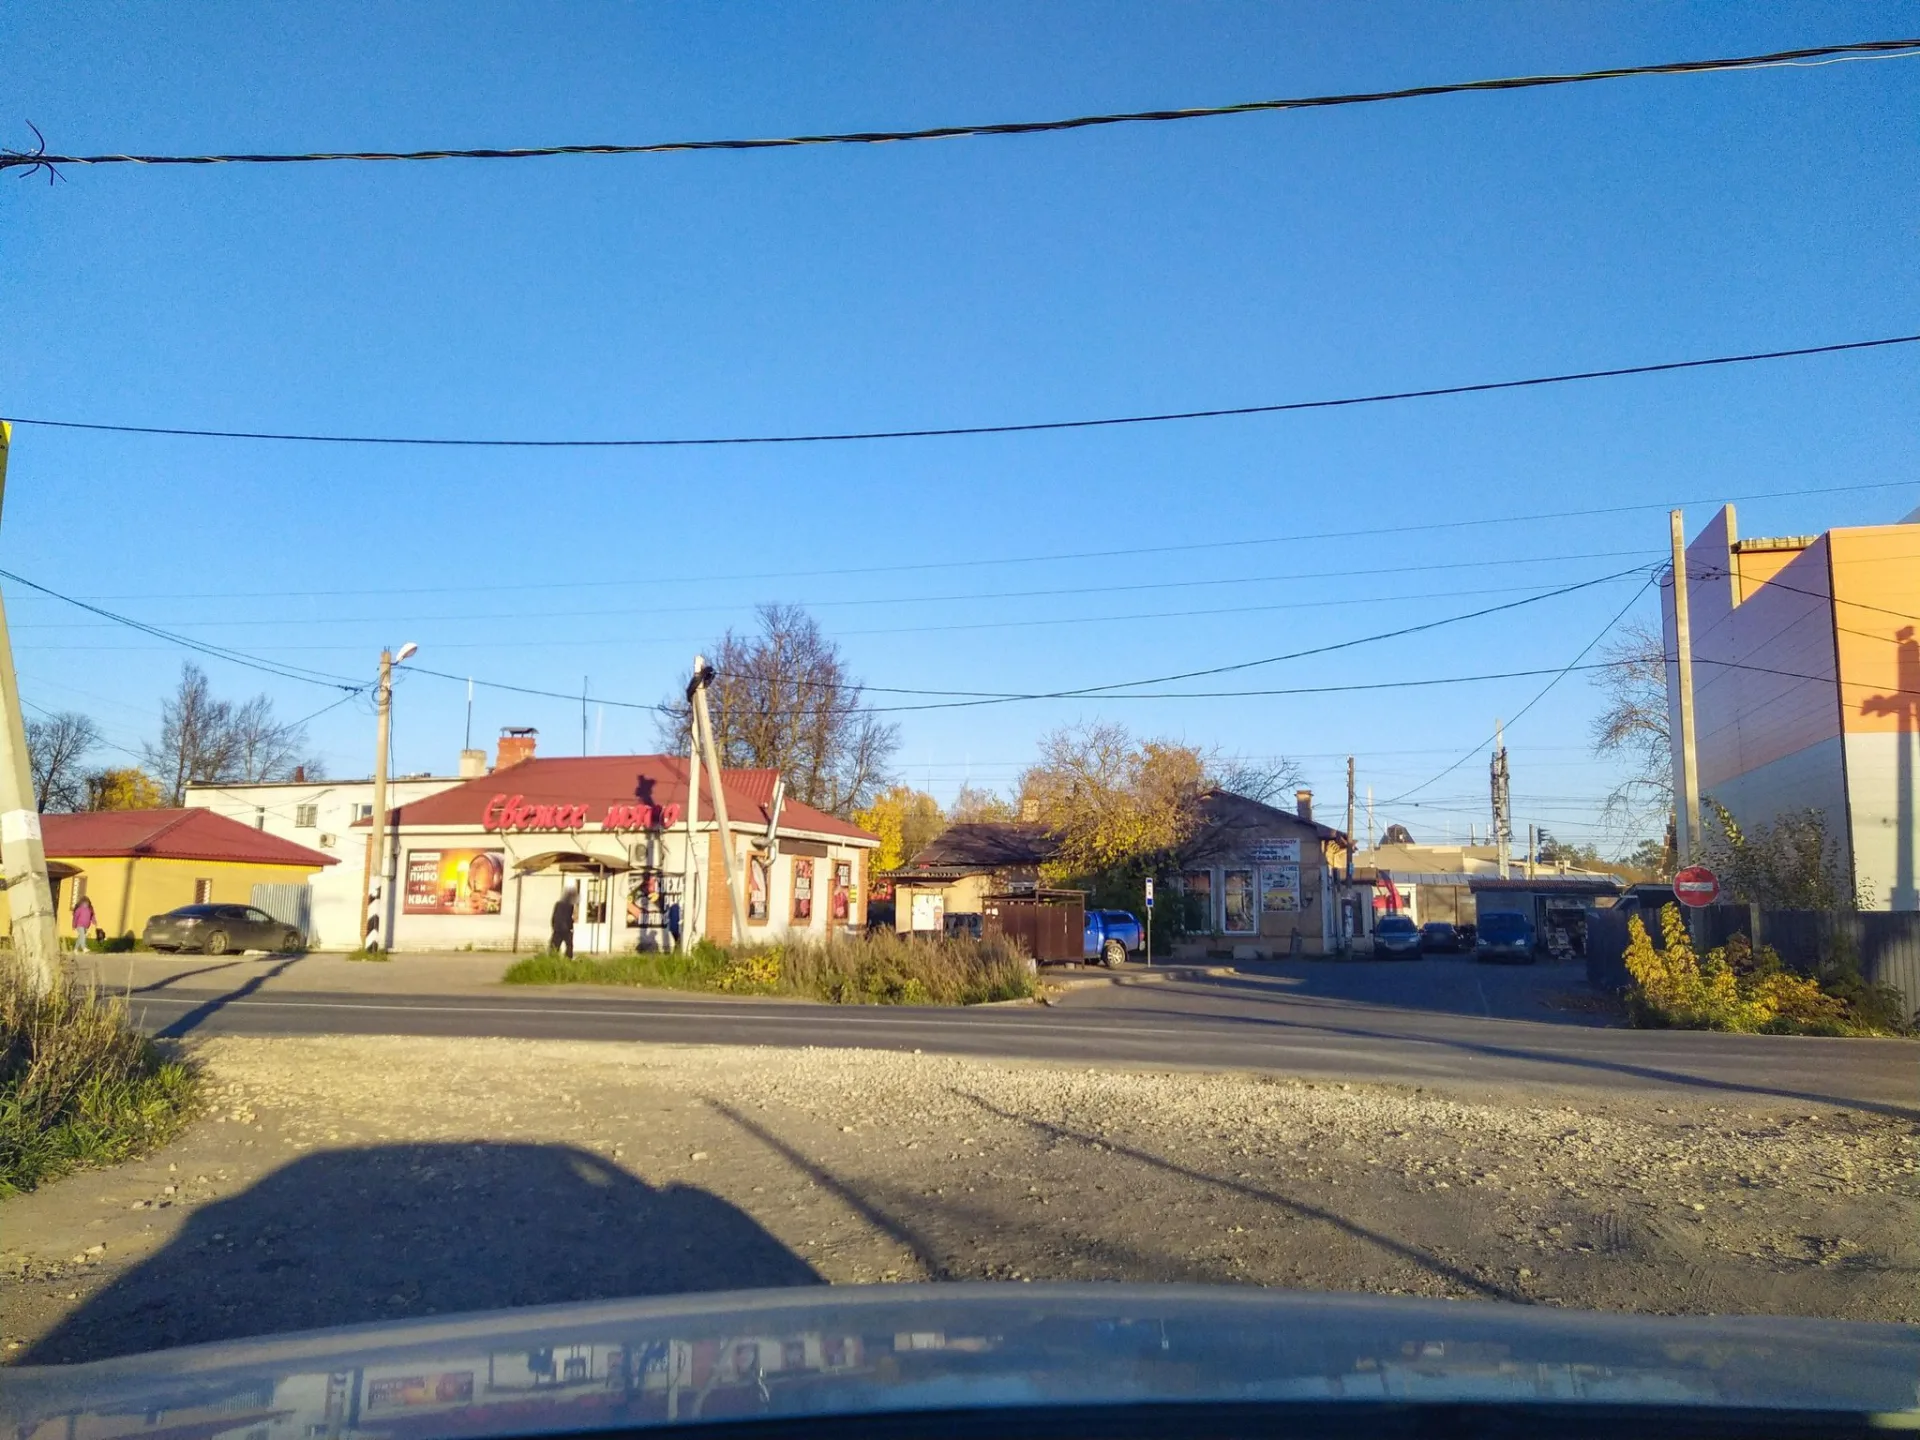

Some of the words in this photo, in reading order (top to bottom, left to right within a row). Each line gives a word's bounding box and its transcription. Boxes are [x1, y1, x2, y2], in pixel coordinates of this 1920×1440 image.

[482, 794, 589, 831] Свежее
[410, 872, 437, 881] ПИВО
[408, 894, 436, 904] КВАС
